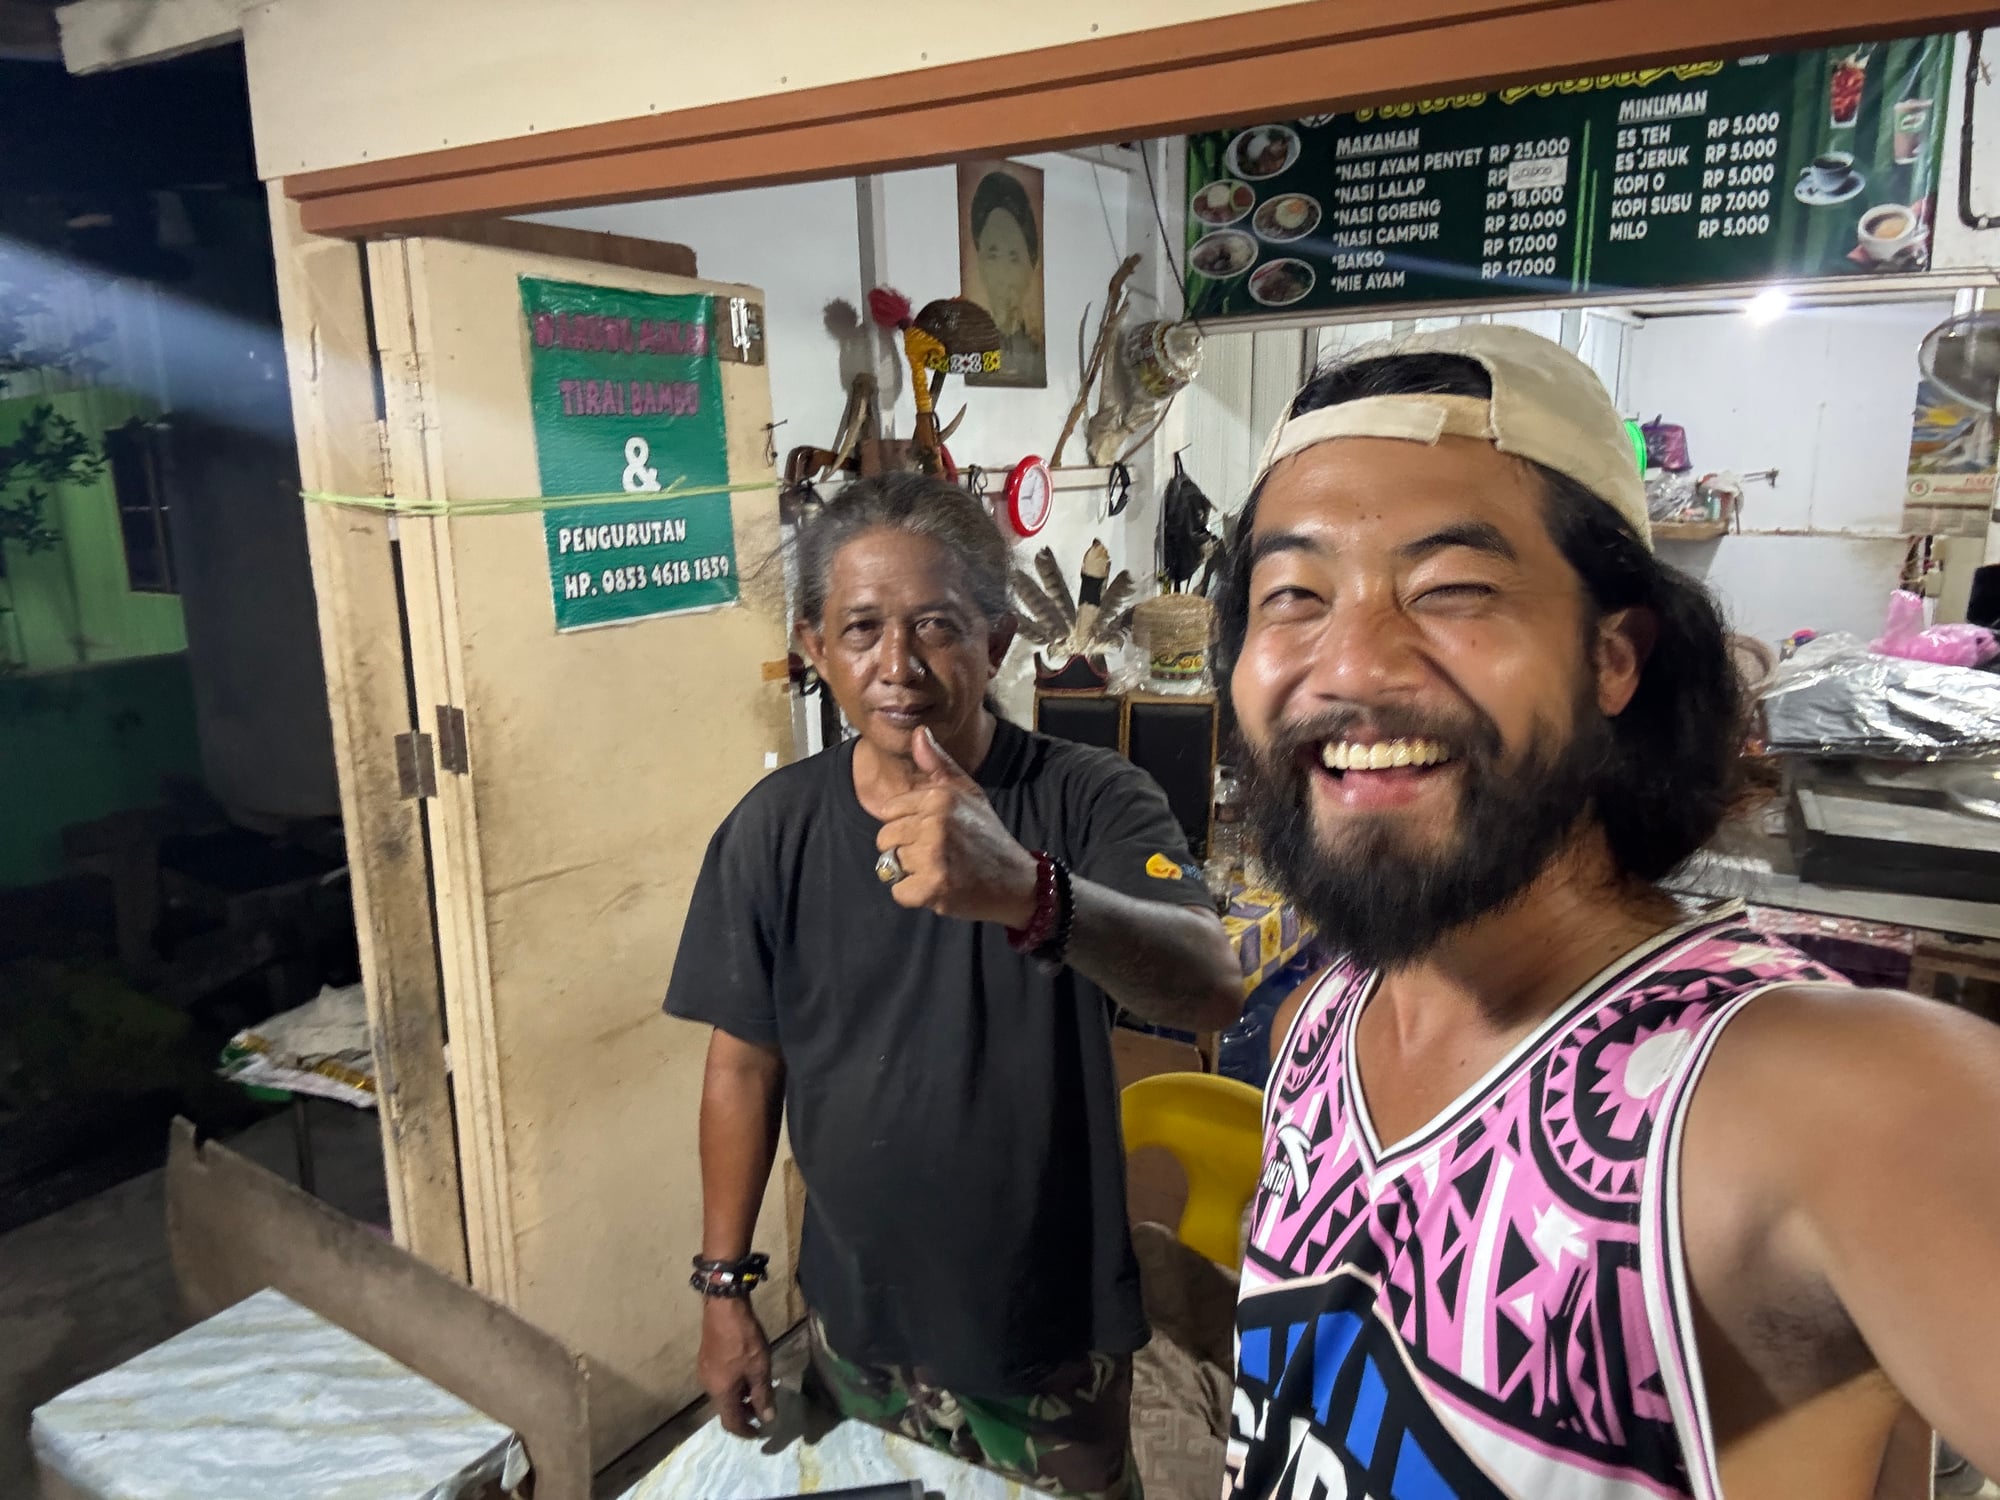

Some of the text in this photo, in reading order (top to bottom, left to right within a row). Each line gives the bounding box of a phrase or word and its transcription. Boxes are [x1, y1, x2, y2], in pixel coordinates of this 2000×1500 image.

[1618, 89, 1708, 122] MINUMAN
[1336, 127, 1420, 156] MAKANAN
[1617, 111, 1780, 149] ES TEH RP 5.000
[1379, 155, 1419, 177] AYAM
[1424, 147, 1483, 171] PENYET
[1489, 144, 1510, 163] RP
[1514, 136, 1570, 160] 25,000
[1615, 153, 1634, 172] ES
[1705, 143, 1727, 164] RP
[1730, 137, 1777, 161] 5.000
[1378, 177, 1426, 200] LALAP
[1488, 168, 1507, 187] RP
[1613, 163, 1775, 195] KOPI O RP 5.000
[1377, 199, 1441, 222] GORENG
[1486, 192, 1507, 210] RP
[1611, 197, 1647, 218] KOPI
[1650, 192, 1693, 216] SUSU
[1700, 193, 1722, 214] RP
[1375, 222, 1440, 245] CAMPUR
[1484, 215, 1505, 233] RP
[1609, 214, 1770, 242] MILO RP 5.000
[1483, 238, 1504, 257] RP
[1365, 270, 1406, 290] AYAM
[1481, 261, 1501, 280] RP
[560, 379, 625, 417] TIRAI
[622, 436, 661, 493] &
[559, 518, 687, 554] PENGURUTAN
[564, 571, 598, 600] HP.
[602, 565, 648, 594] 0853
[651, 560, 691, 587] 4618
